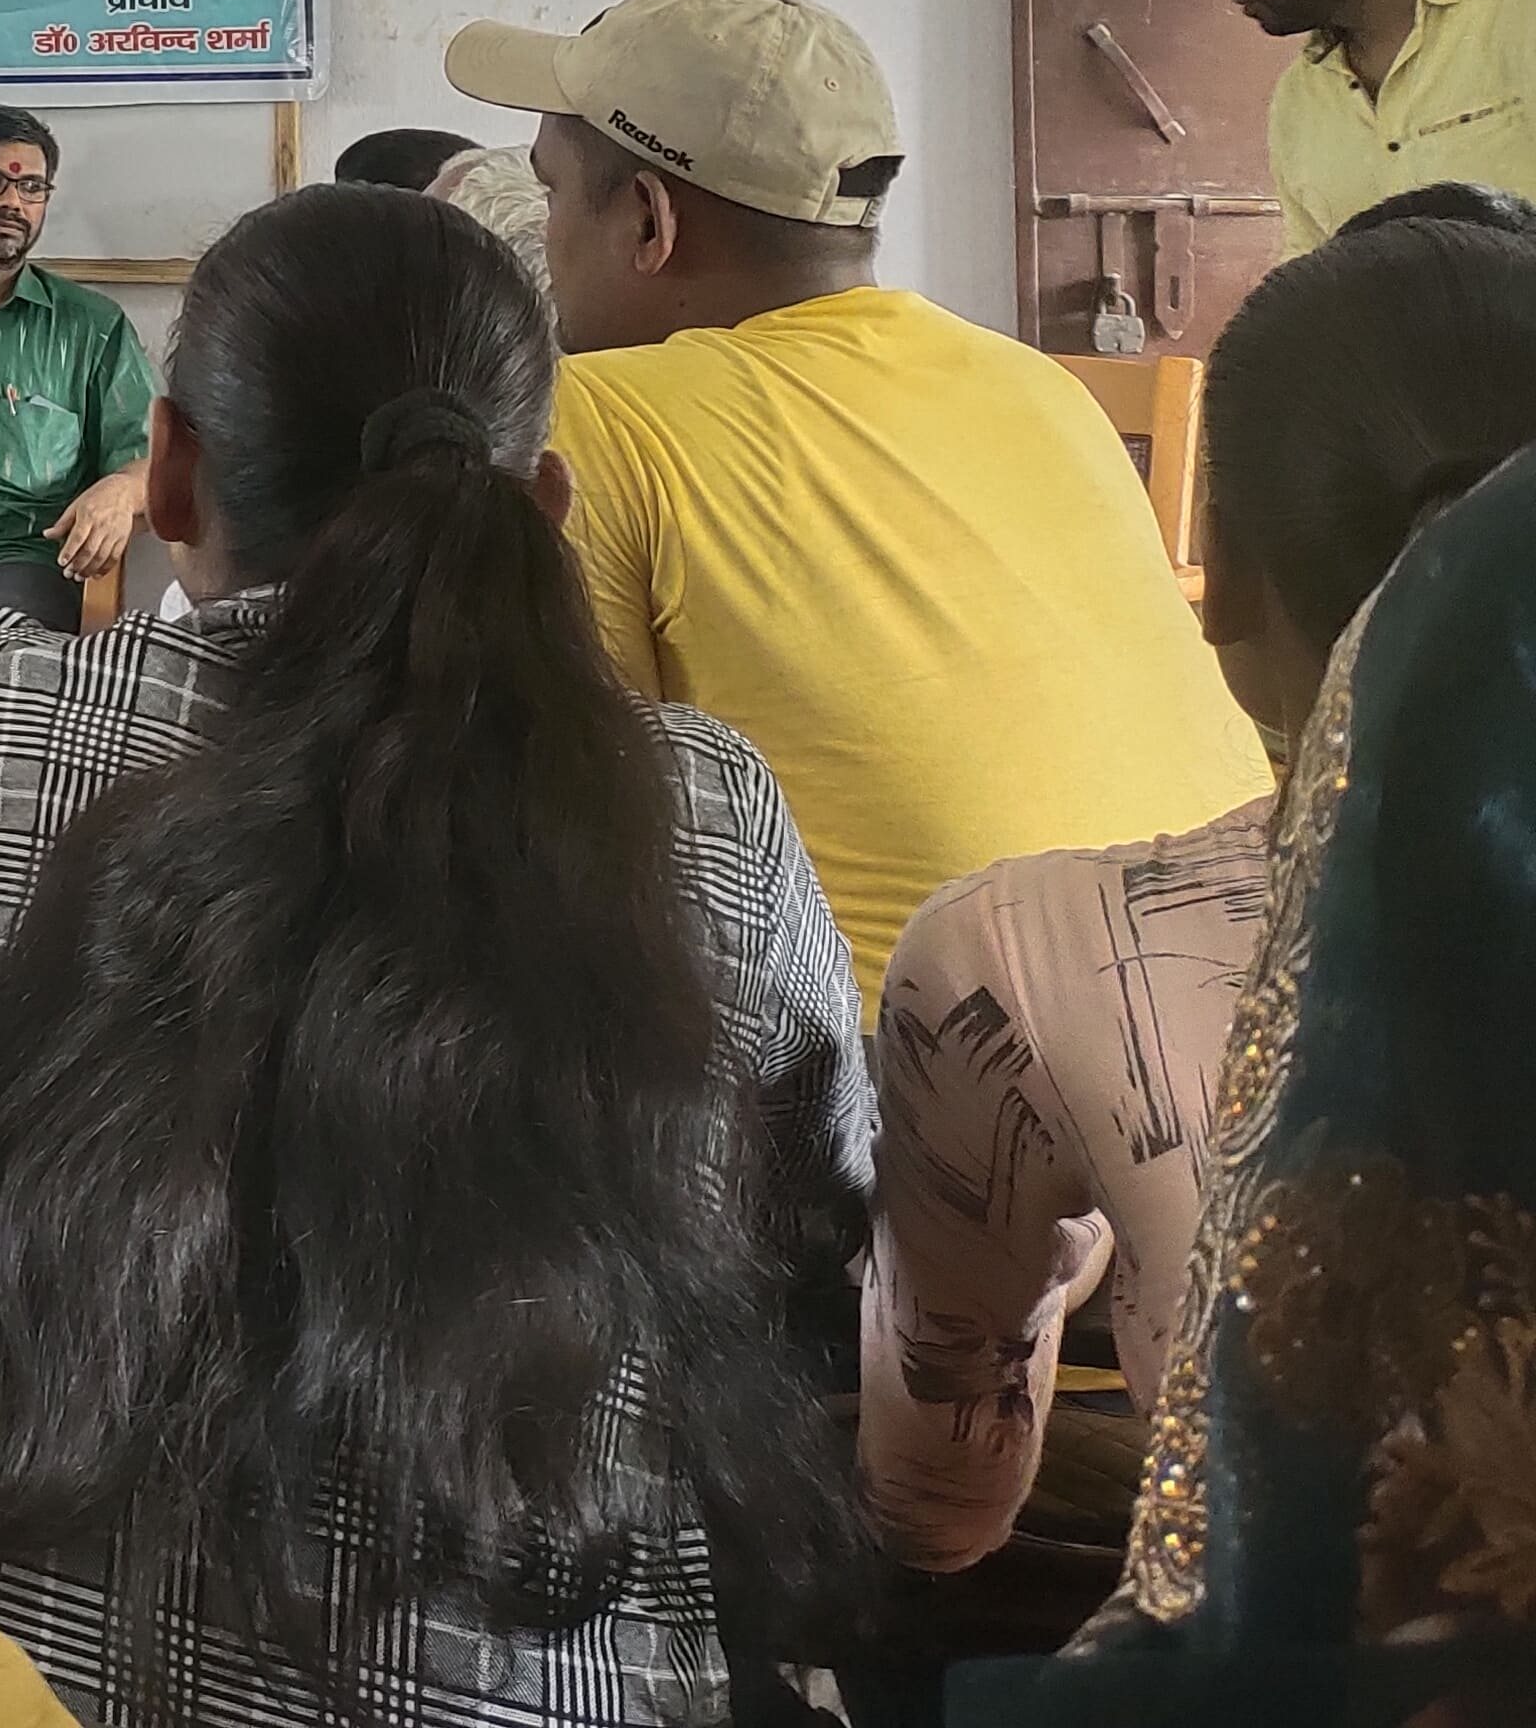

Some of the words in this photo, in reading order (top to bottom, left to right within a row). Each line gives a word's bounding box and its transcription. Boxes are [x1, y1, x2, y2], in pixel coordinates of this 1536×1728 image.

[87, 22, 199, 53] अरविन्द
[205, 21, 271, 51] शर्मा
[608, 108, 694, 172] Reebok
